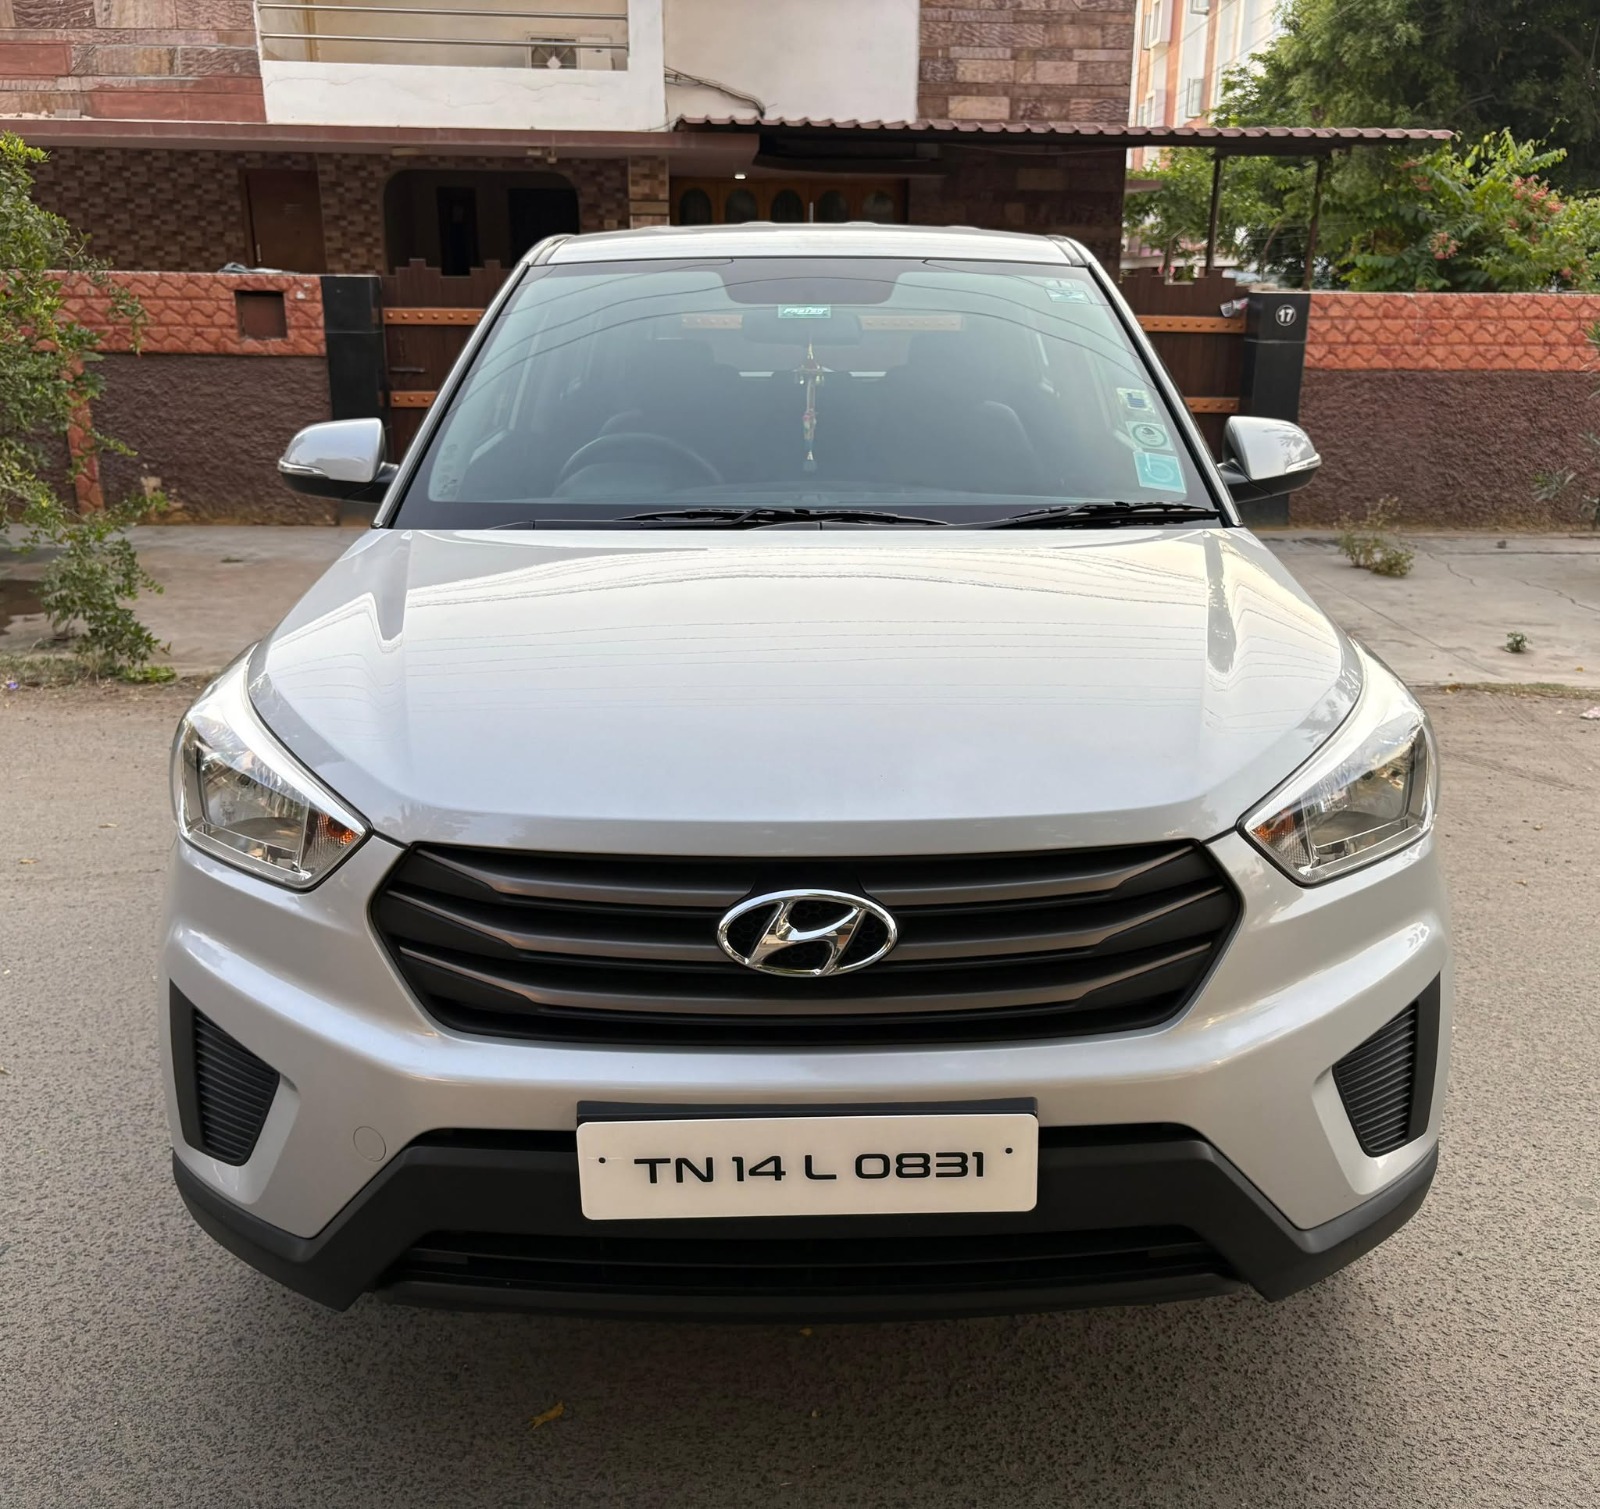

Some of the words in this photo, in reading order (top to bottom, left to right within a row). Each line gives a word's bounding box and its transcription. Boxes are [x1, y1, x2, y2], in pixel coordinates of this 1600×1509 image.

[1278, 308, 1294, 323] 17
[633, 1156, 714, 1184] TN
[731, 1155, 787, 1182] 14
[804, 1154, 838, 1181] L
[854, 1151, 984, 1180] 0831
